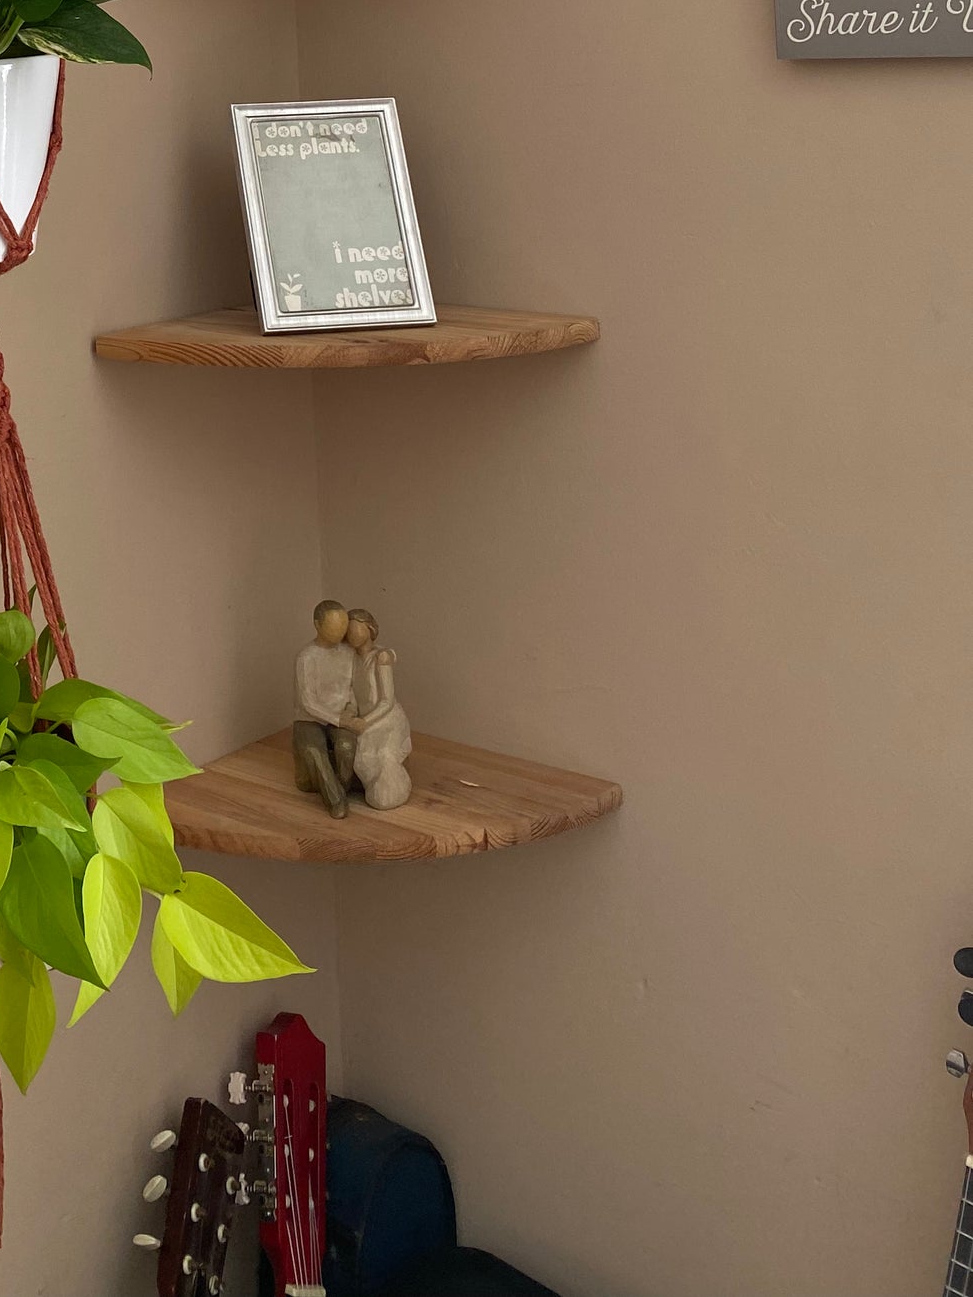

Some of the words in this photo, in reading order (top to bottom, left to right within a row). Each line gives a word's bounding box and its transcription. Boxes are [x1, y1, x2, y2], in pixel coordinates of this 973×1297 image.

[908, 2, 939, 34] it
[265, 121, 315, 139] don't
[319, 118, 368, 136] need
[299, 137, 360, 160] plants.
[347, 240, 405, 263] need
[354, 267, 409, 285] more
[335, 283, 414, 309] shelves
